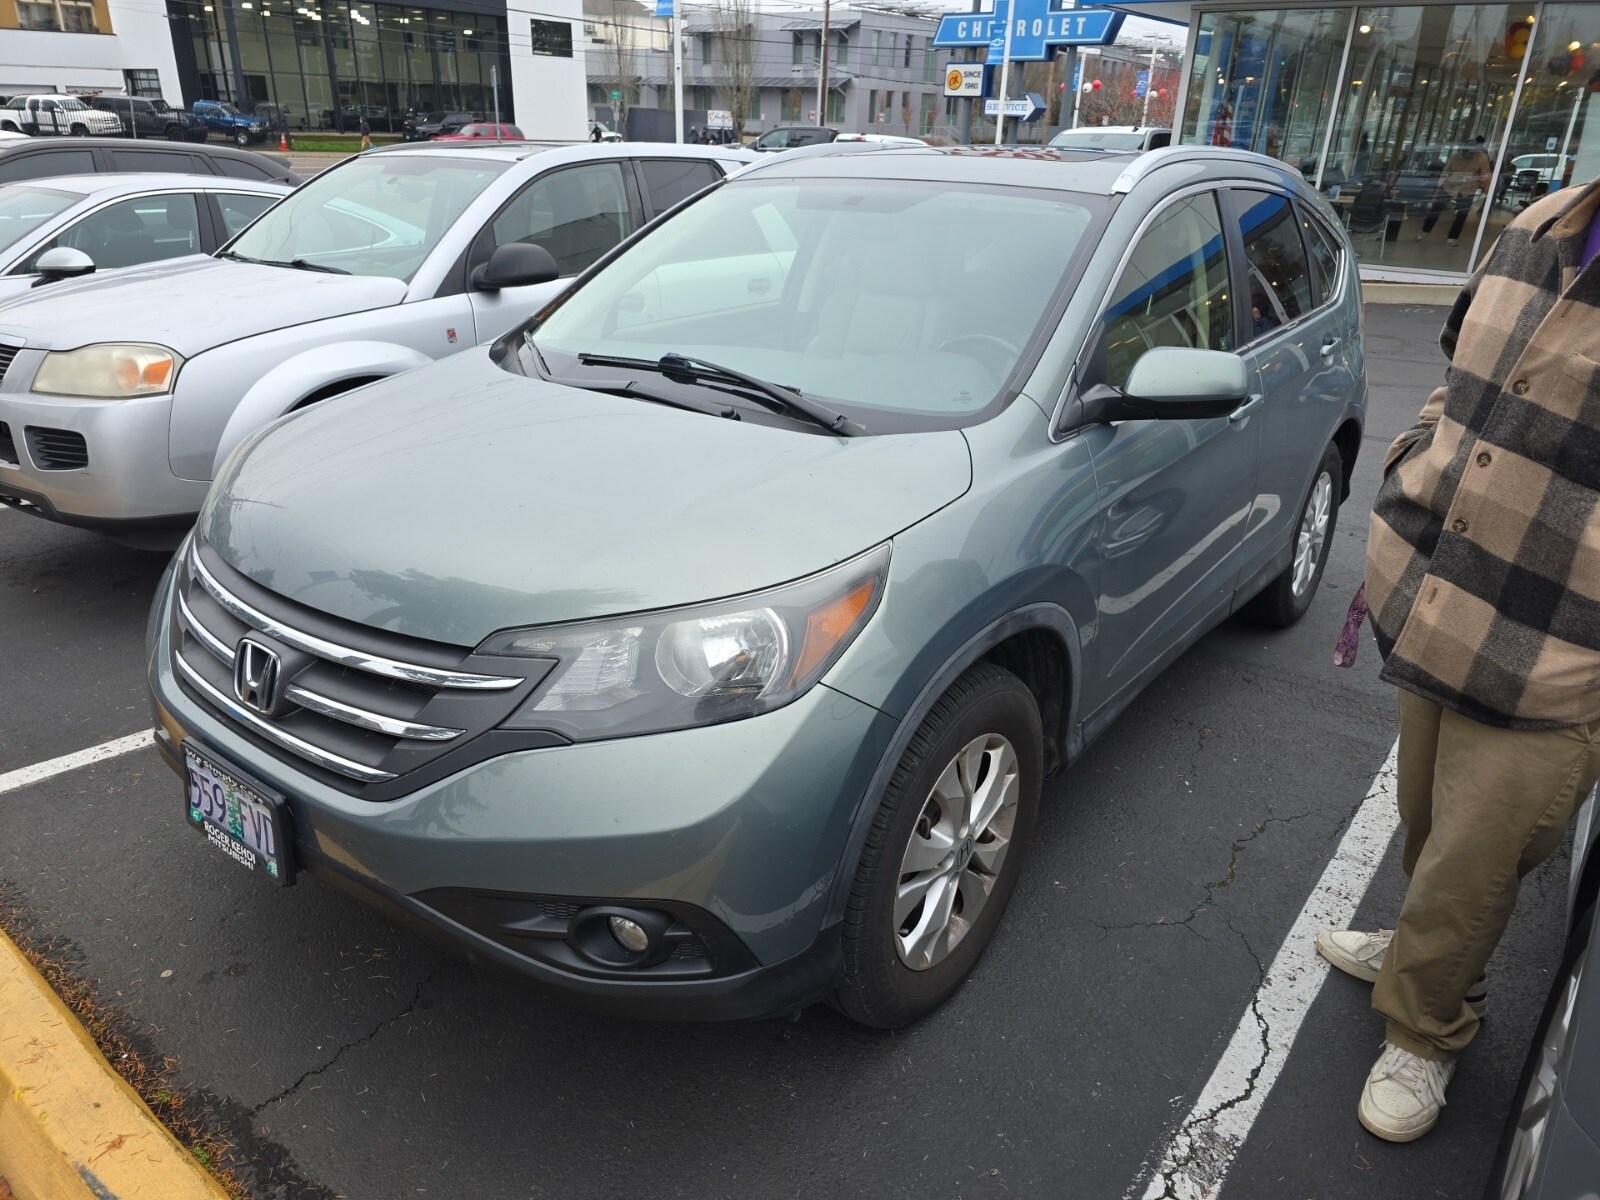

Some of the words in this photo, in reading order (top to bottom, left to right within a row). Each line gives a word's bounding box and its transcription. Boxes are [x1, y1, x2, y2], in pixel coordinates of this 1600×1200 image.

[957, 17, 1086, 38] CHEROLET
[987, 103, 1027, 111] SEVICE
[185, 748, 201, 764] We
[188, 767, 226, 823] 559
[204, 821, 230, 847] ROGER
[231, 839, 256, 864] KEHDI
[208, 834, 254, 870] MITSUBISHI
